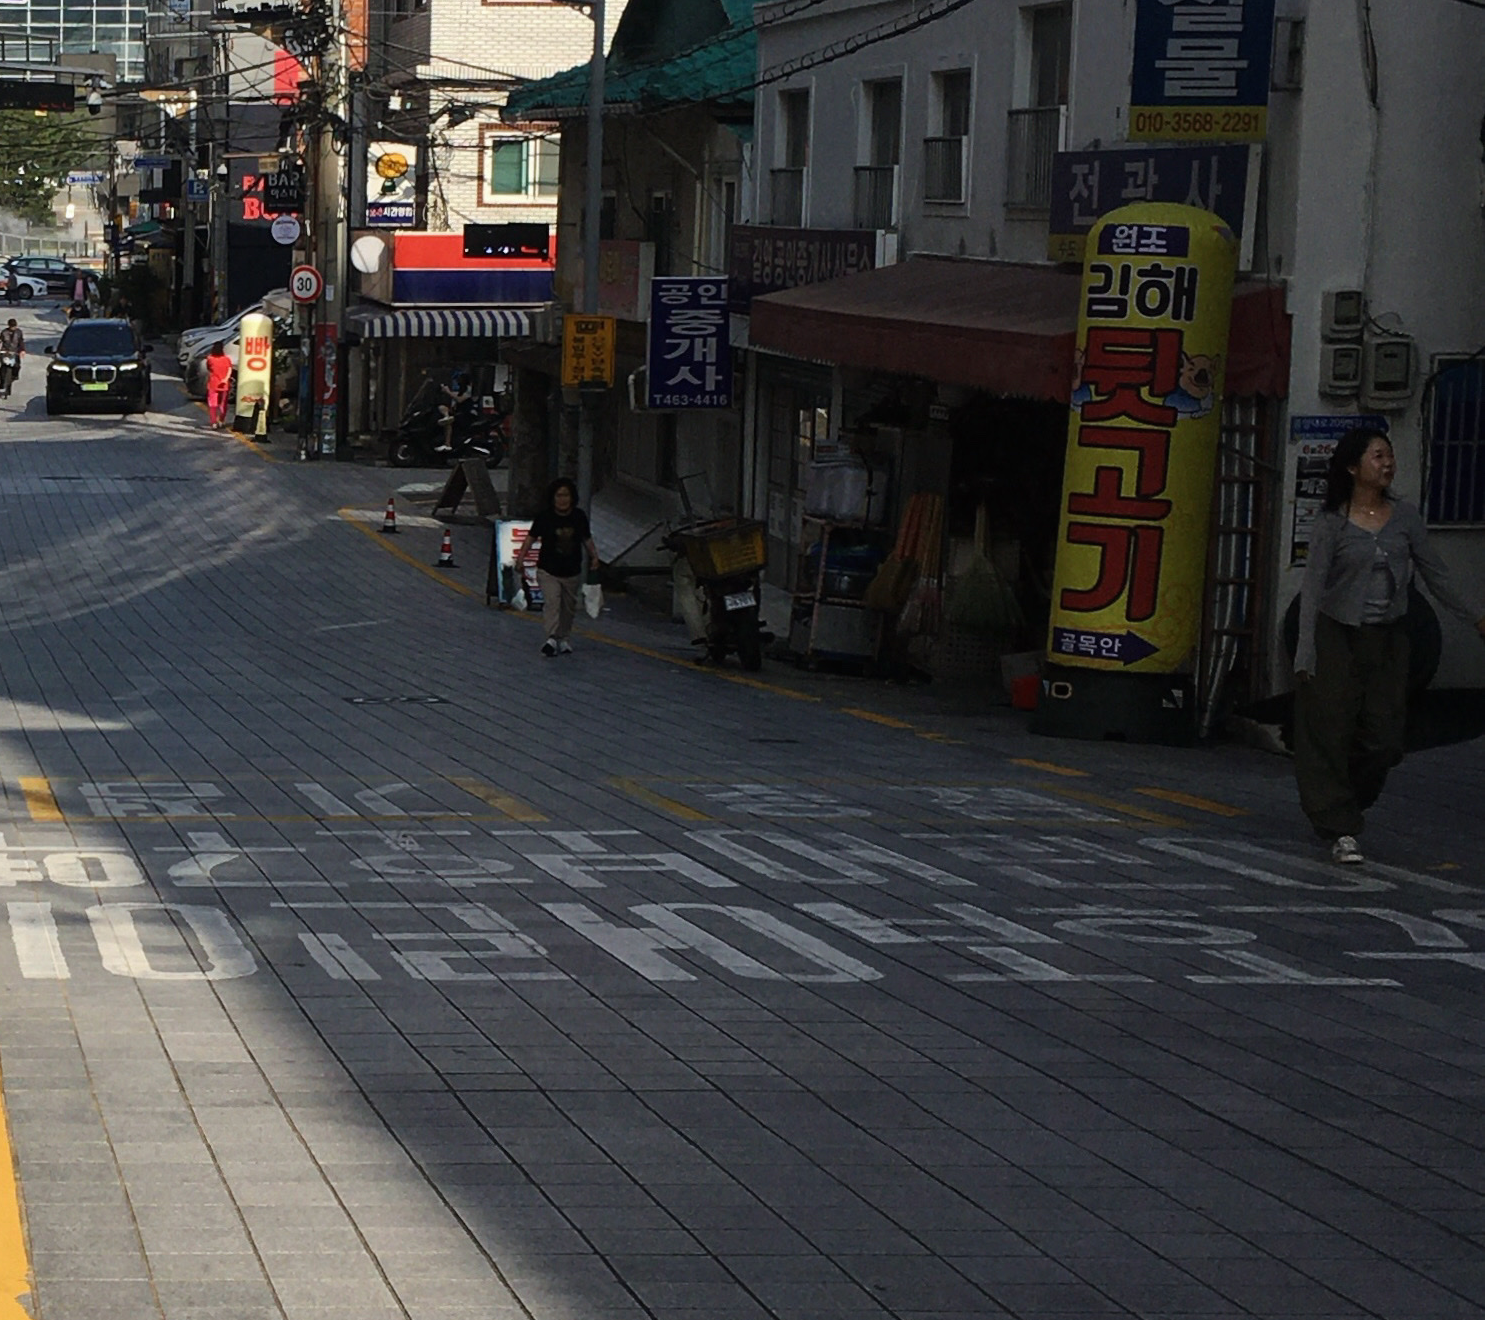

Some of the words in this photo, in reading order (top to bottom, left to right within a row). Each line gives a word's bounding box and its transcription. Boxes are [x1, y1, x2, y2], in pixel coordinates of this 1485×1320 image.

[1135, 112, 1260, 134] 010-3568-2291
[1111, 225, 1168, 254] 원조
[297, 277, 312, 291] 30
[658, 284, 728, 305] 공인
[1086, 262, 1200, 323] 김해
[245, 336, 271, 372] 빵
[662, 309, 725, 392] 중개사
[653, 394, 728, 406] T463-4416
[1059, 327, 1183, 622] 뒷고기
[1059, 632, 1123, 657] 골목안
[793, 903, 1485, 987] 보호구
